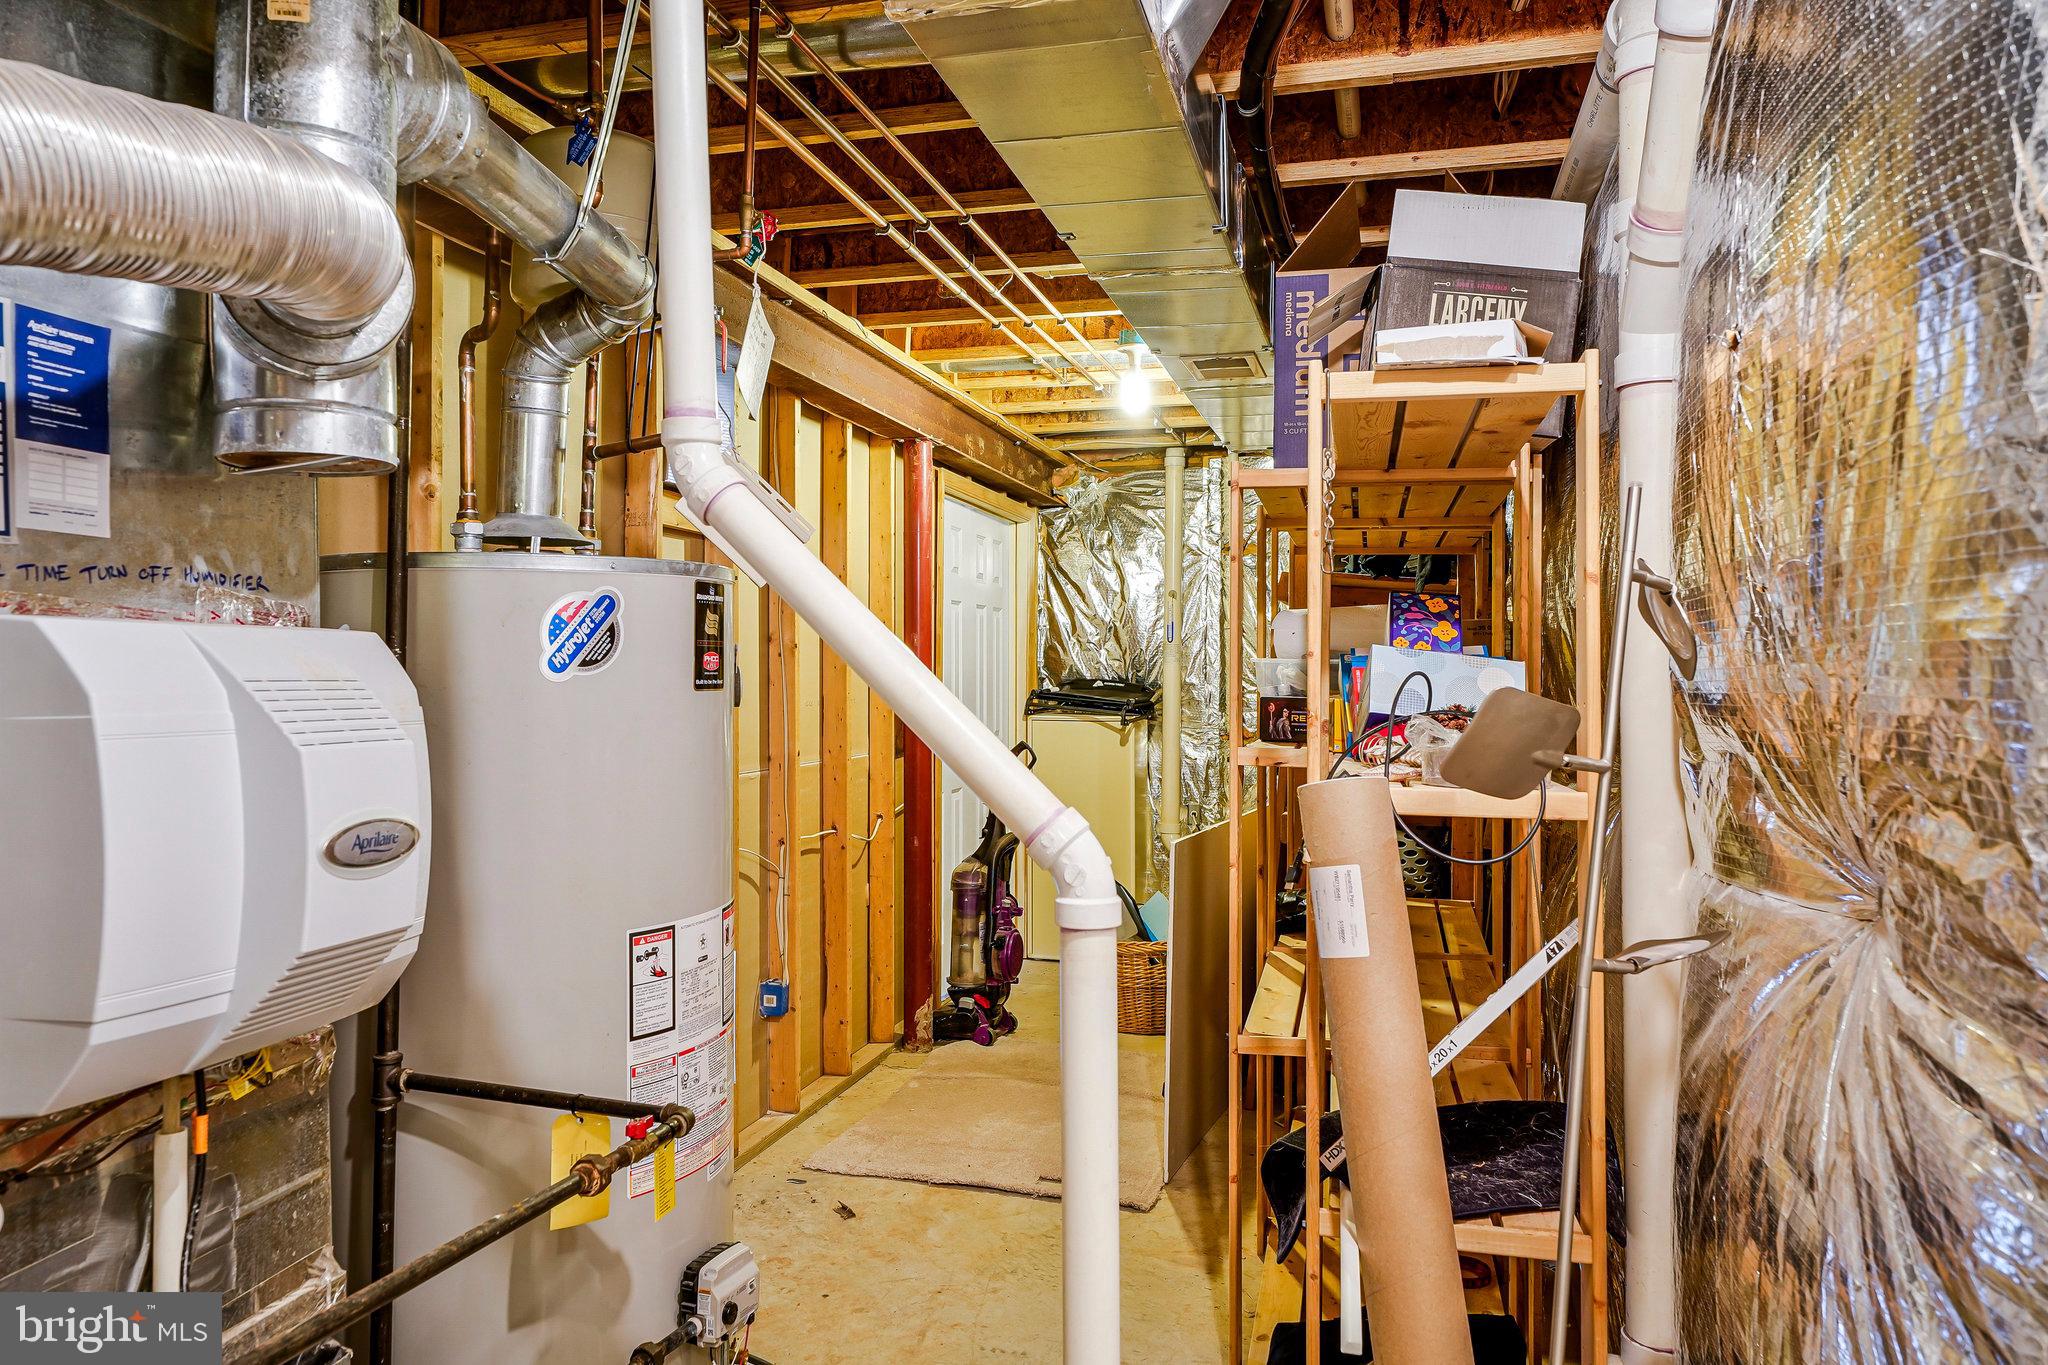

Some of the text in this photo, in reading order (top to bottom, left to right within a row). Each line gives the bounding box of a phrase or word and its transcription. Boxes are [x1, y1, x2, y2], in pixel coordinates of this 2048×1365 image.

[1285, 292, 1295, 337] mediana
[1429, 293, 1528, 326] LARCENY
[17, 564, 71, 582] TIME
[79, 564, 128, 584] TURN
[139, 566, 174, 581] OFF
[551, 616, 595, 669] Hydrojet
[351, 832, 399, 855] Aprilaire
[646, 933, 668, 943] DANGER
[1324, 1140, 1346, 1163] HDX
